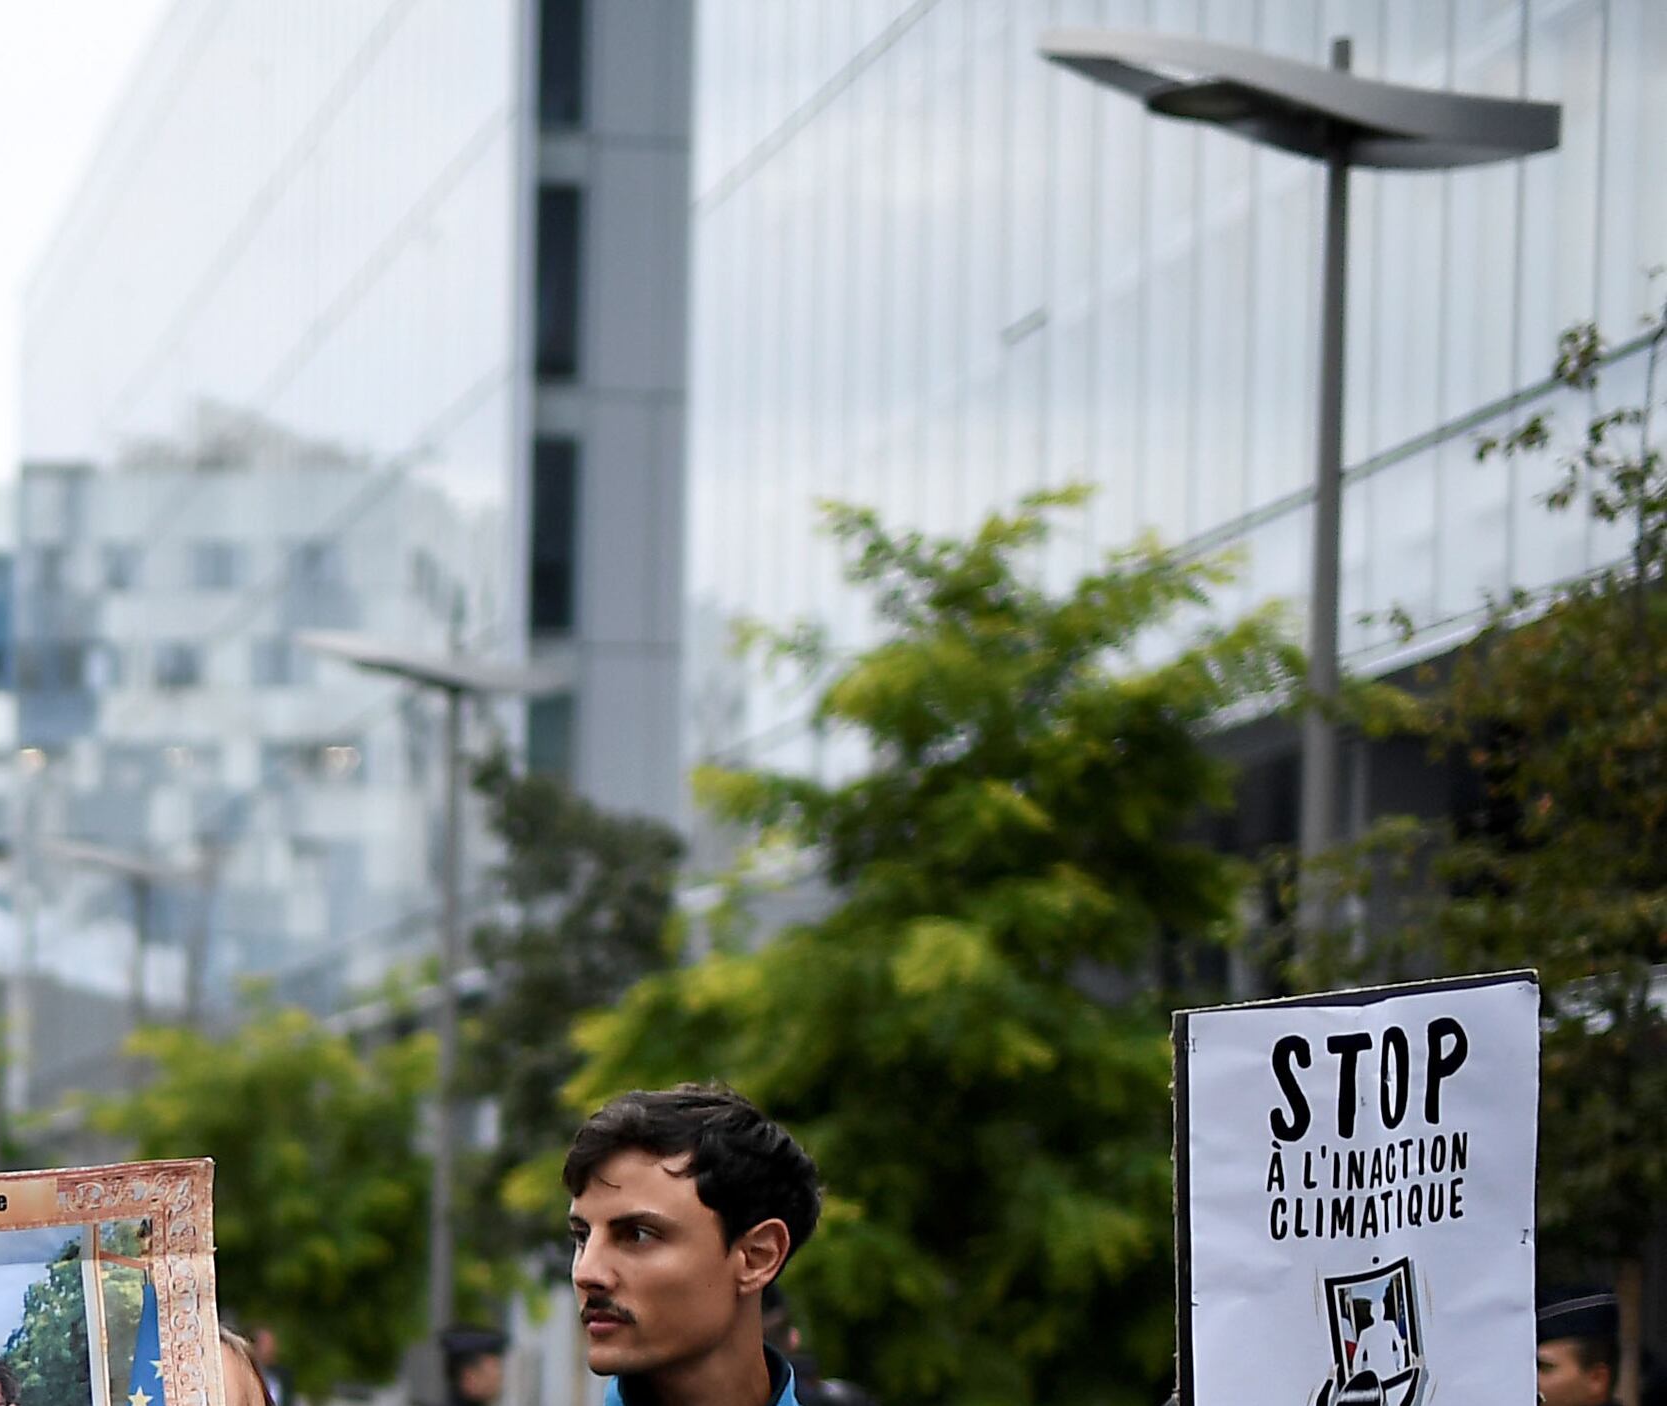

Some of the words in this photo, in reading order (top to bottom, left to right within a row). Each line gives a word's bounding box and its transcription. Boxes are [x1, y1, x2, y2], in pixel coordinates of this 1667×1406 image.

[1270, 1017, 1468, 1142] STOP
[1267, 1139, 1284, 1193] À
[1303, 1131, 1468, 1191] L'INACTION
[1270, 1177, 1464, 1241] CLIMATIQUE
